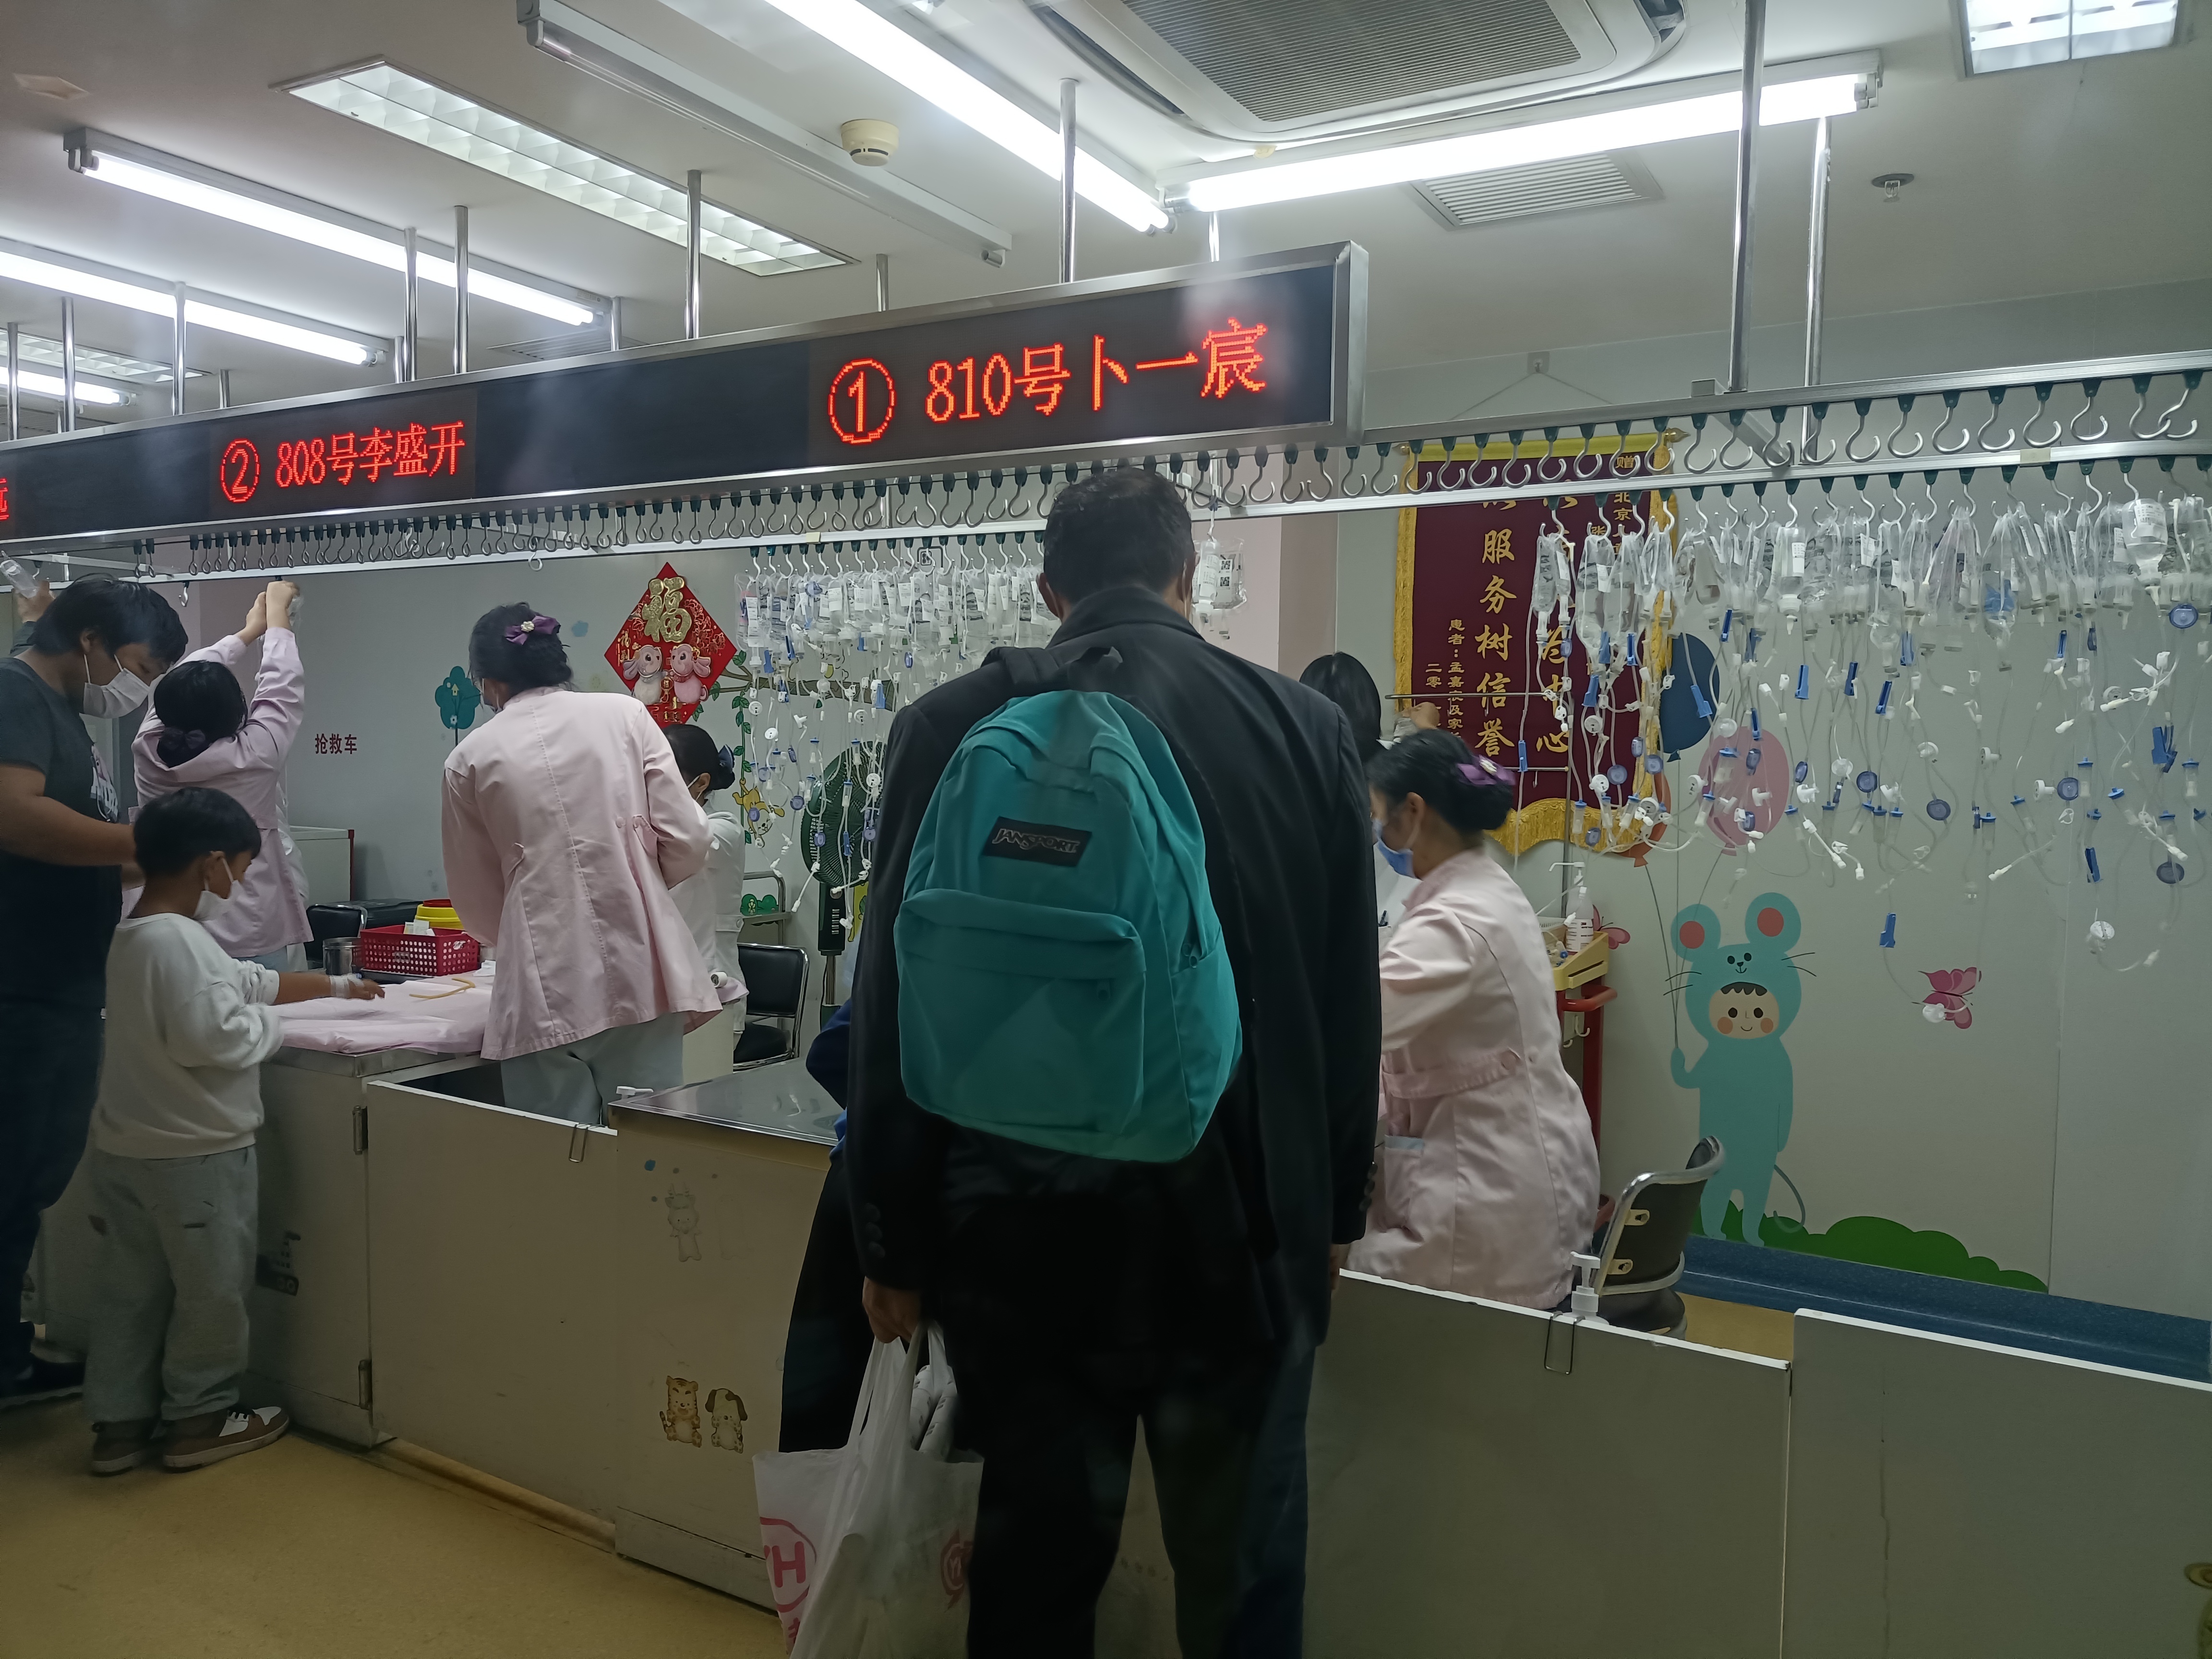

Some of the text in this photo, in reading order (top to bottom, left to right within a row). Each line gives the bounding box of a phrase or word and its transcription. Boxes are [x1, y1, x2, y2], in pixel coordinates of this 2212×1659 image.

[926, 317, 1268, 422] 810号卜一宸
[276, 421, 465, 487] 808号李盛开
[1615, 456, 1635, 469] 赠
[1475, 500, 1517, 757] 服务树信誉
[315, 733, 357, 755] 抢救车
